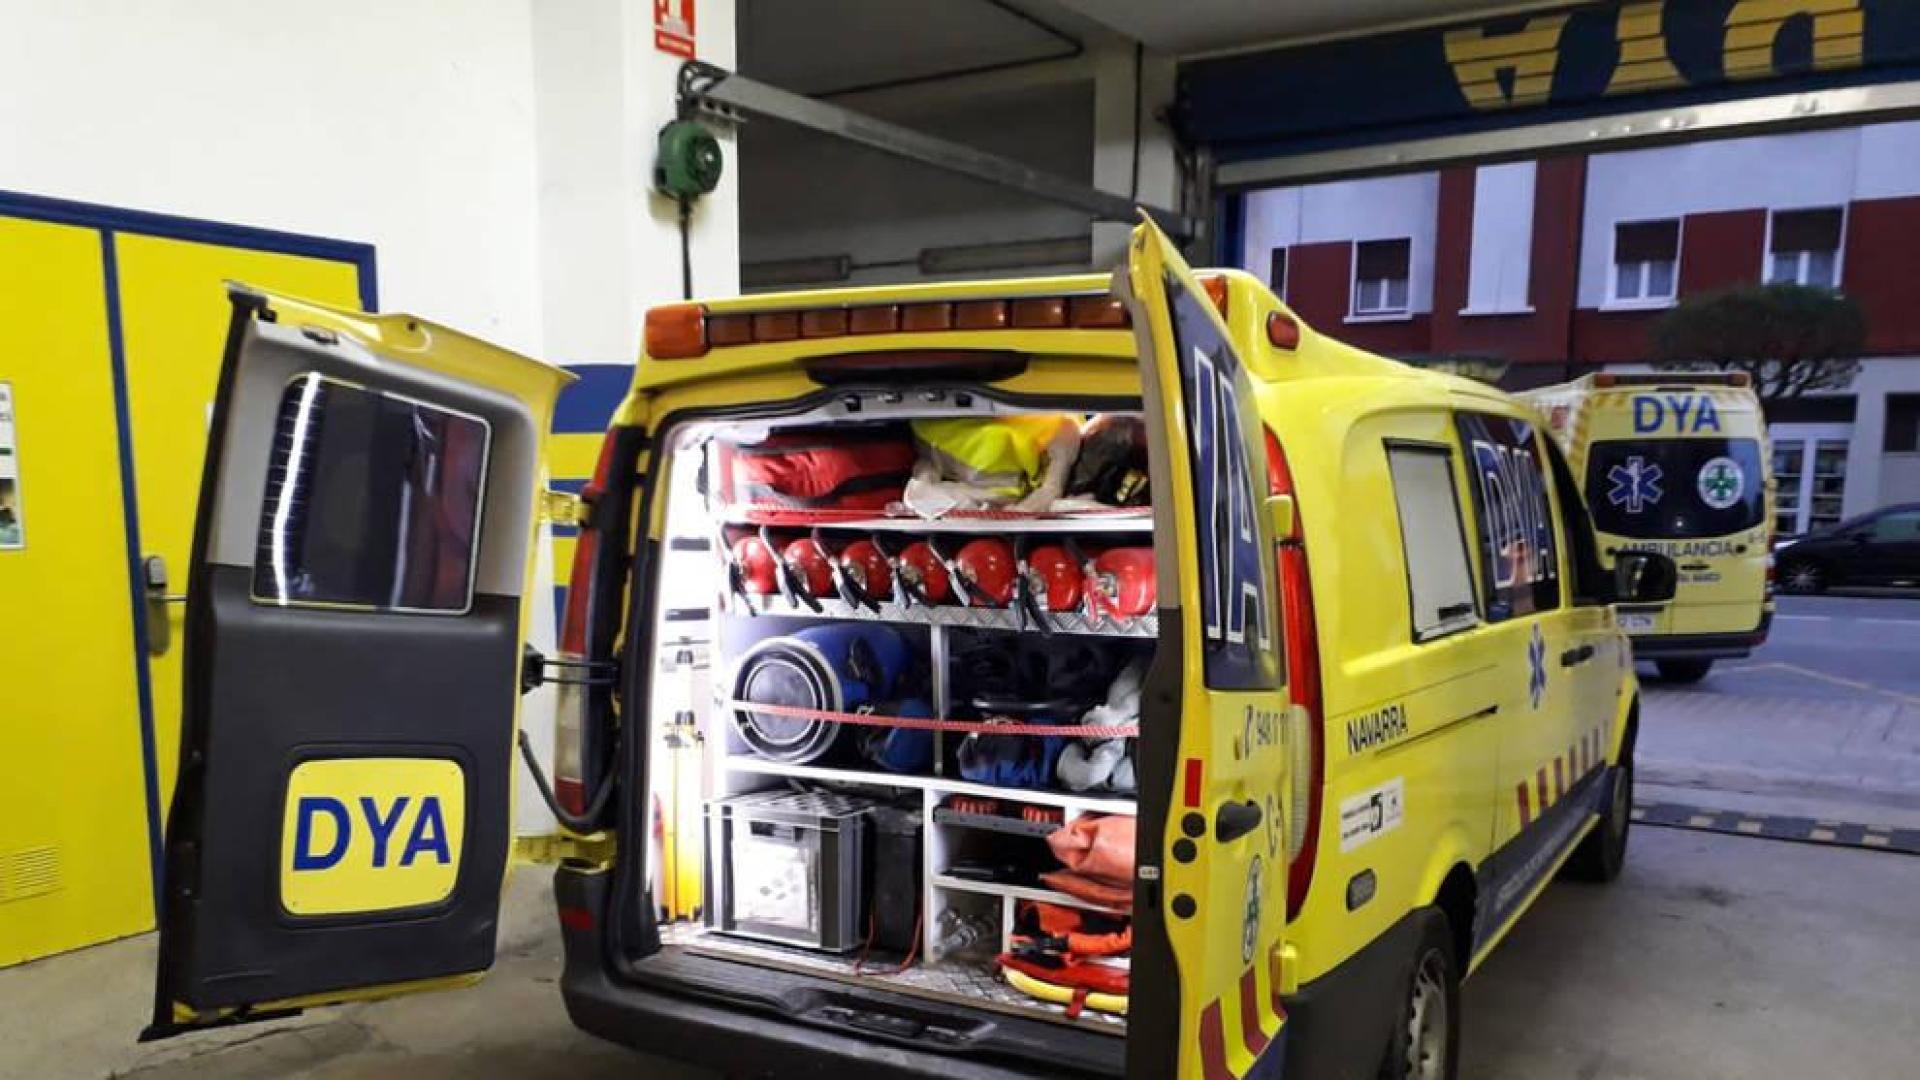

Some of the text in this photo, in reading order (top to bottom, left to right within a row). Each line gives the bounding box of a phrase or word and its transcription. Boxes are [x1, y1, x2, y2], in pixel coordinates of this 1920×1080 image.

[1633, 395, 1720, 433] DYA
[1347, 703, 1409, 755] NAVARRA
[292, 796, 451, 871] DYA
